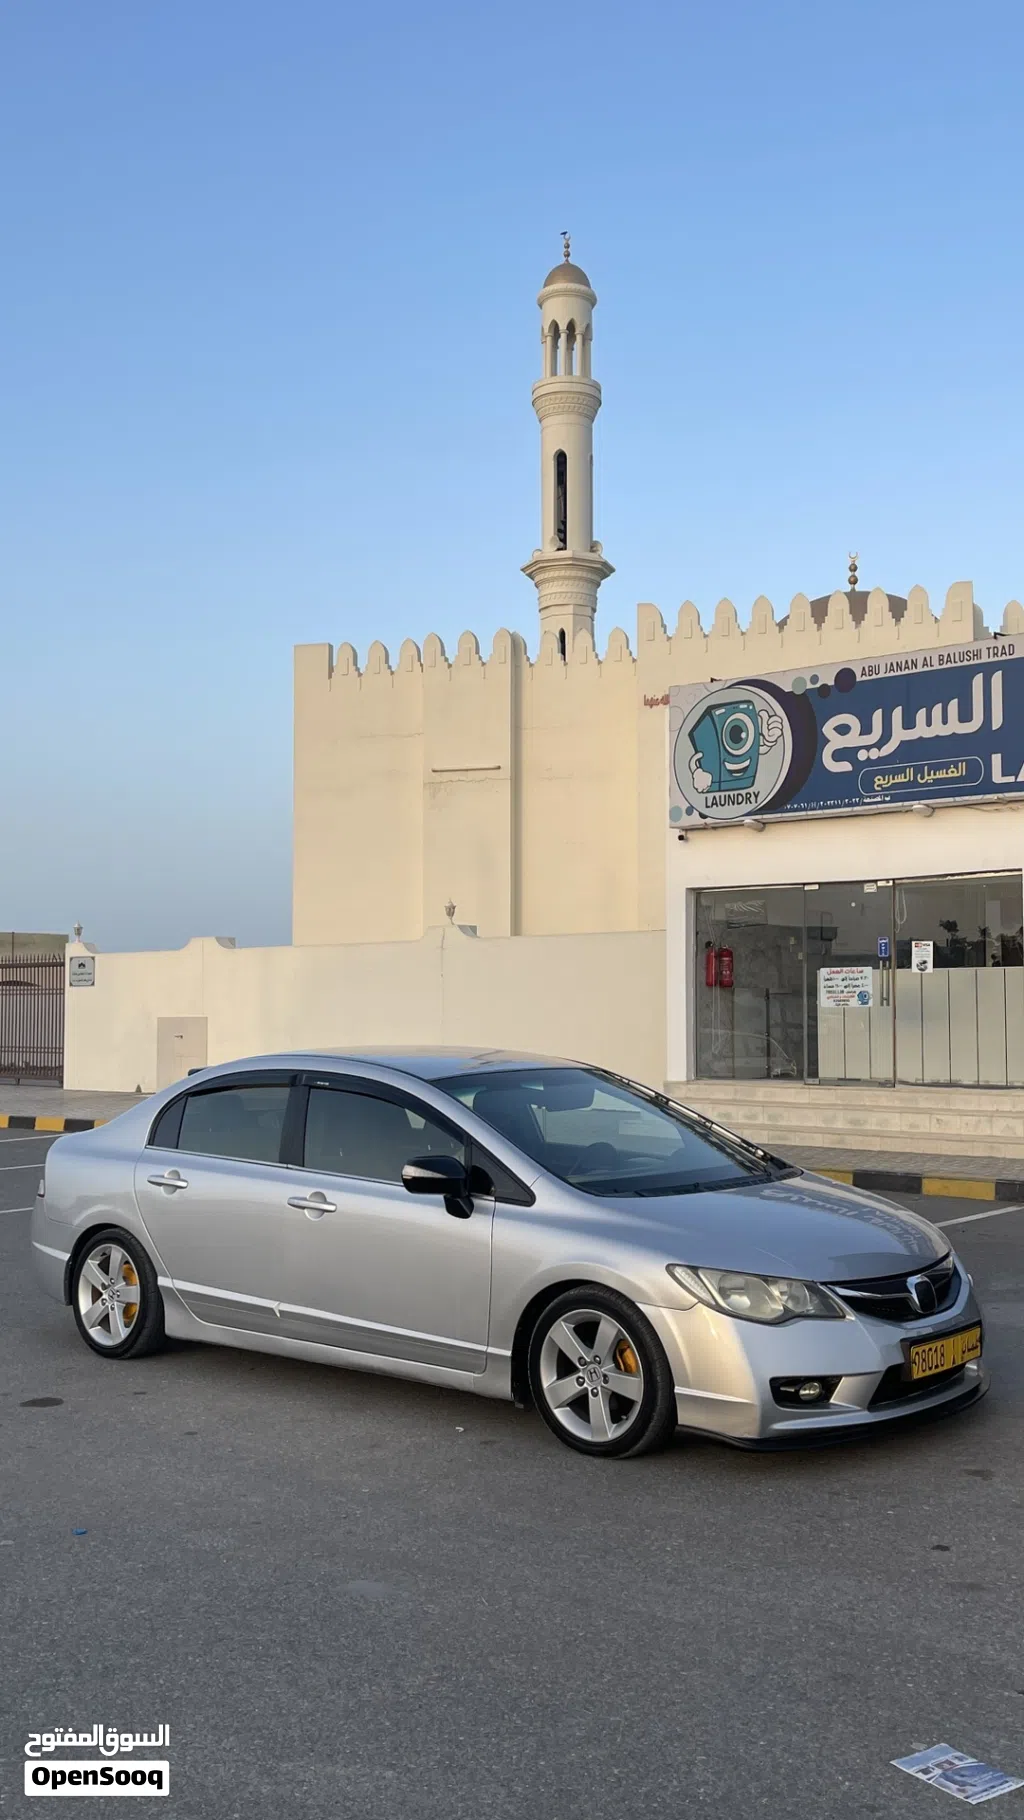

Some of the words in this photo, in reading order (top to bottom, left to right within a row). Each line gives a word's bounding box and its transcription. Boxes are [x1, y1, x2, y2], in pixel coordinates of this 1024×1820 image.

[860, 664, 880, 678] ABU
[884, 658, 918, 675] JANAN
[921, 656, 934, 669] AL
[938, 649, 982, 666] BALUSHI
[986, 643, 1015, 659] TRAD
[821, 670, 1003, 773] السريع
[873, 767, 914, 791] السريع
[917, 761, 966, 784] الغسيل
[991, 753, 1024, 783] L
[705, 790, 760, 809] LAUNDRY
